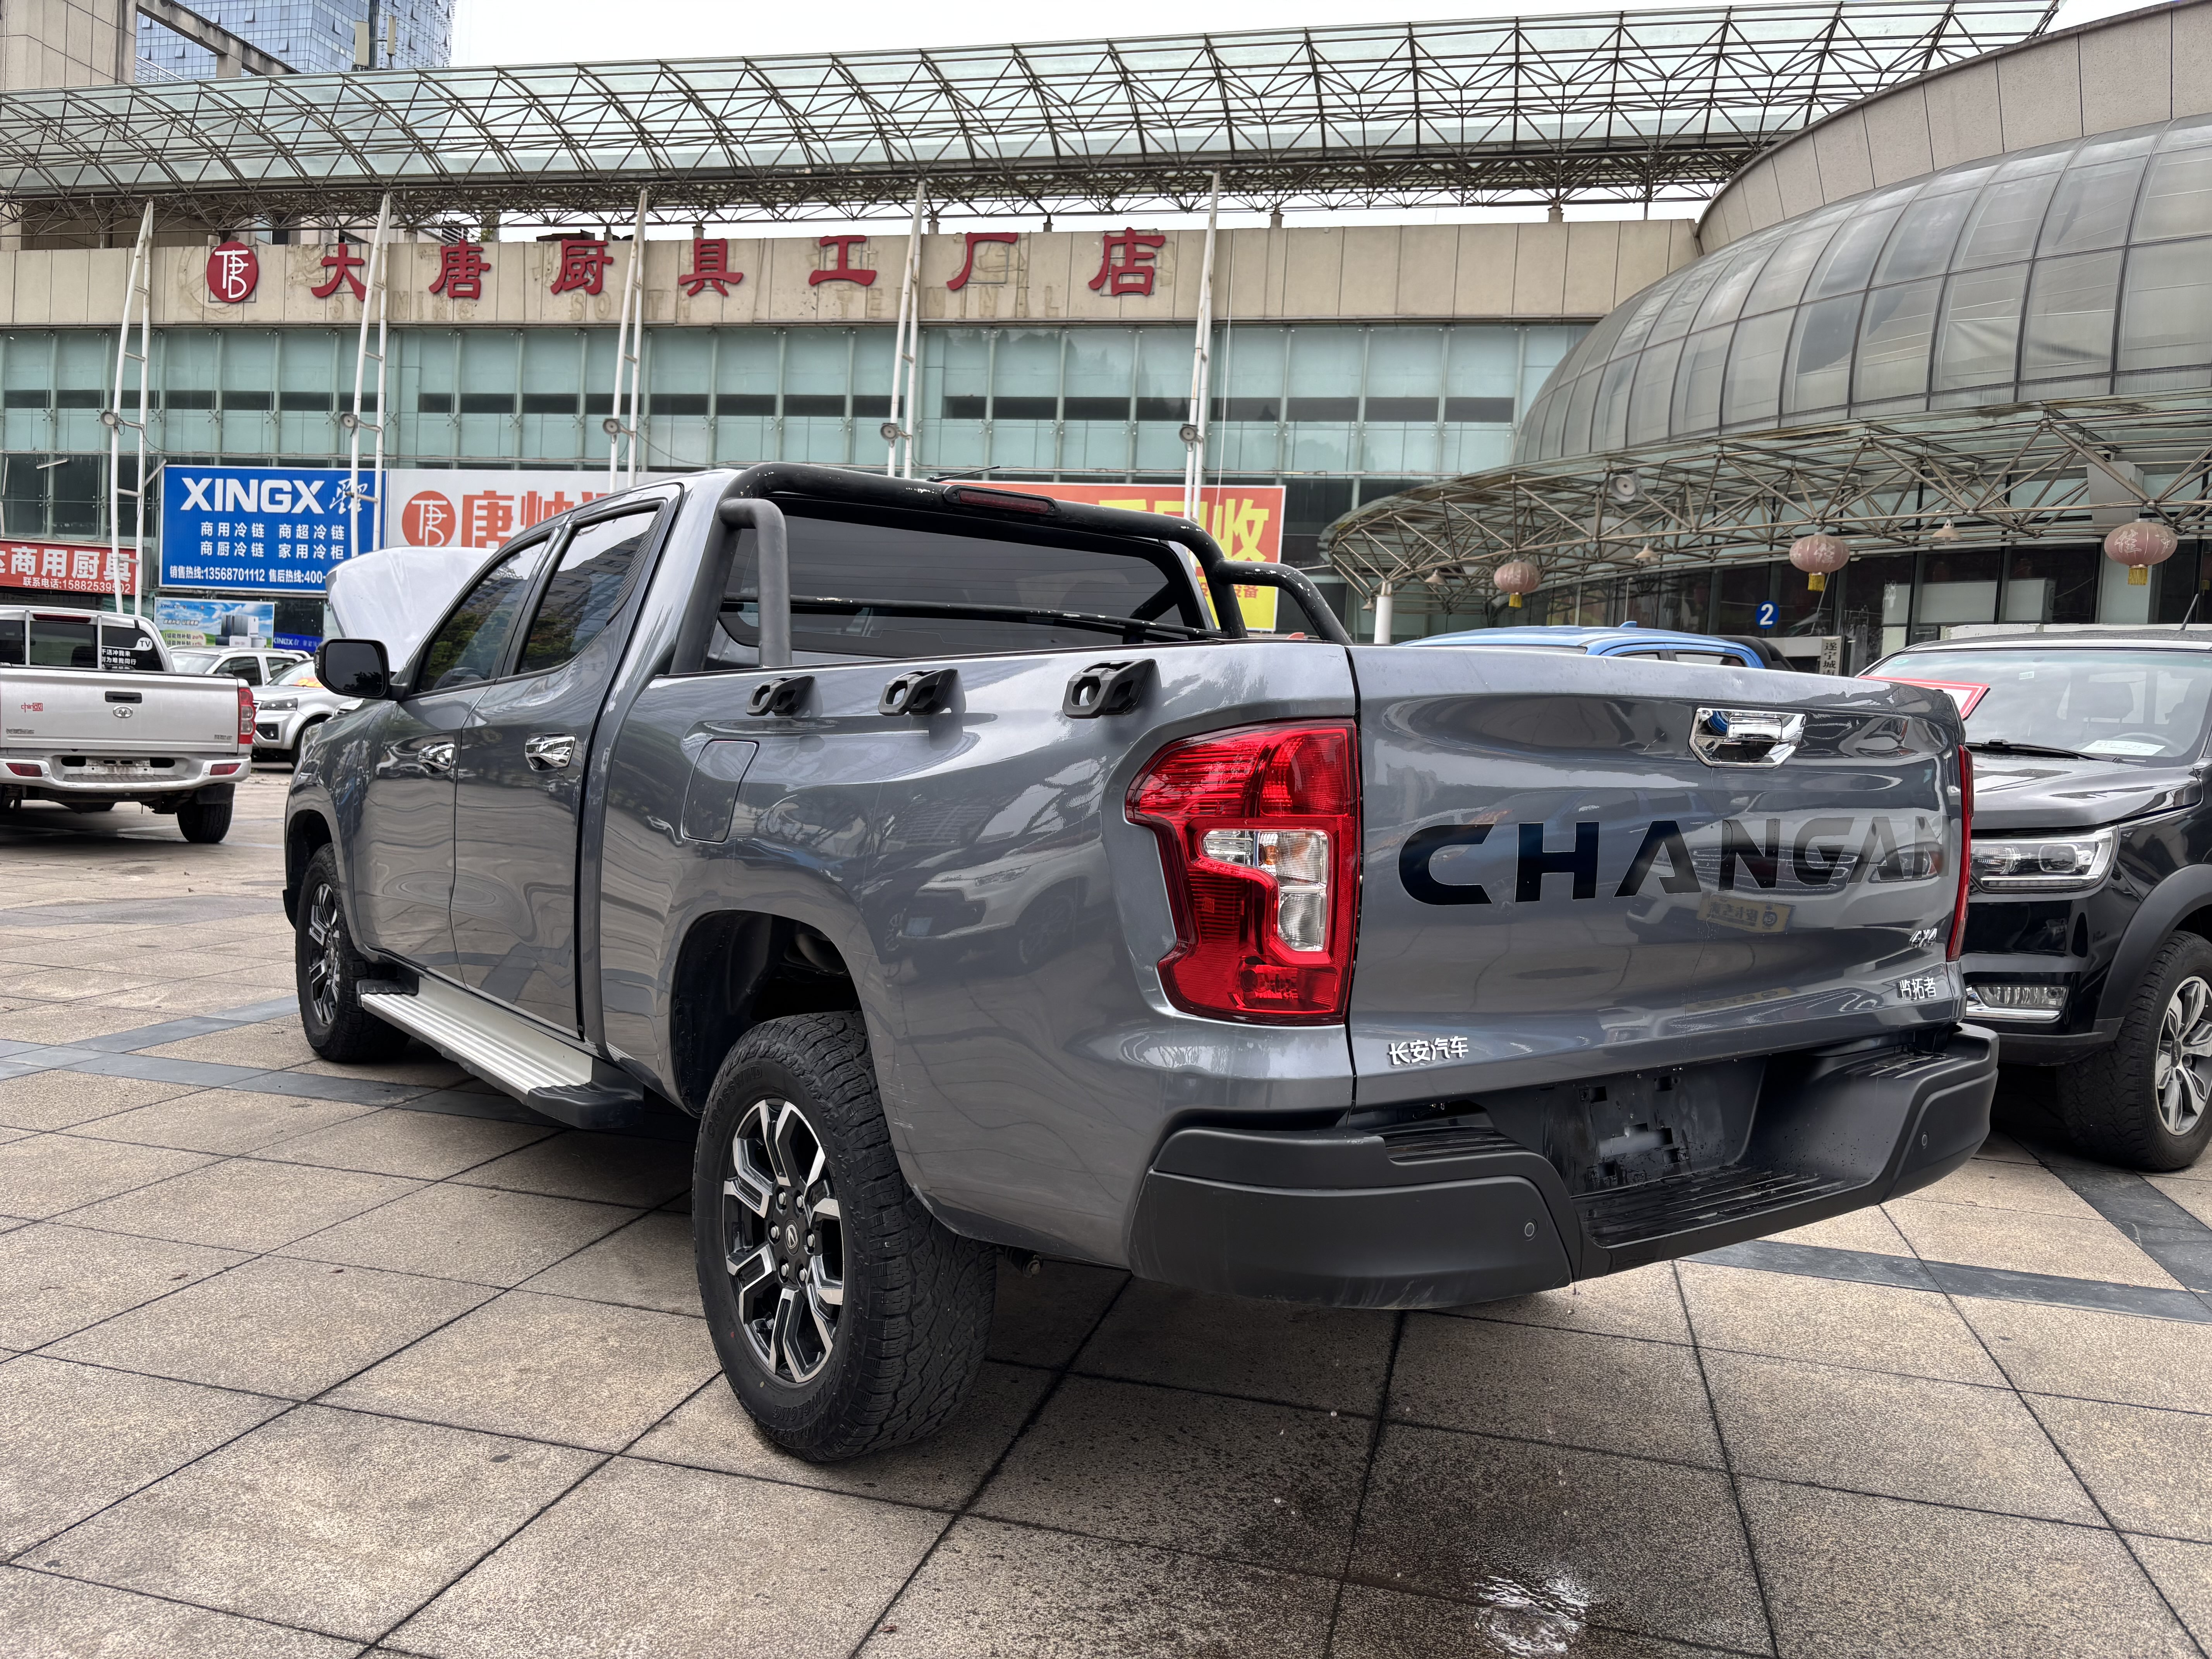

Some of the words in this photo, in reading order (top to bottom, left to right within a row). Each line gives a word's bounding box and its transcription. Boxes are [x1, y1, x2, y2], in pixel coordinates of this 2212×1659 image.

[311, 227, 1166, 301] 大唐厨具工厂店
[180, 477, 325, 514] XINGX
[201, 522, 264, 538] 商用冷链
[278, 524, 345, 540] 商超冷链
[200, 541, 264, 557] 商厨冷链
[278, 543, 344, 560] 家用冷柜
[170, 565, 265, 582] 销售热线:13568701112
[1759, 603, 1774, 625] 2
[1398, 815, 1951, 906] CHANGAN
[1388, 1036, 1469, 1065] 长安汽车
